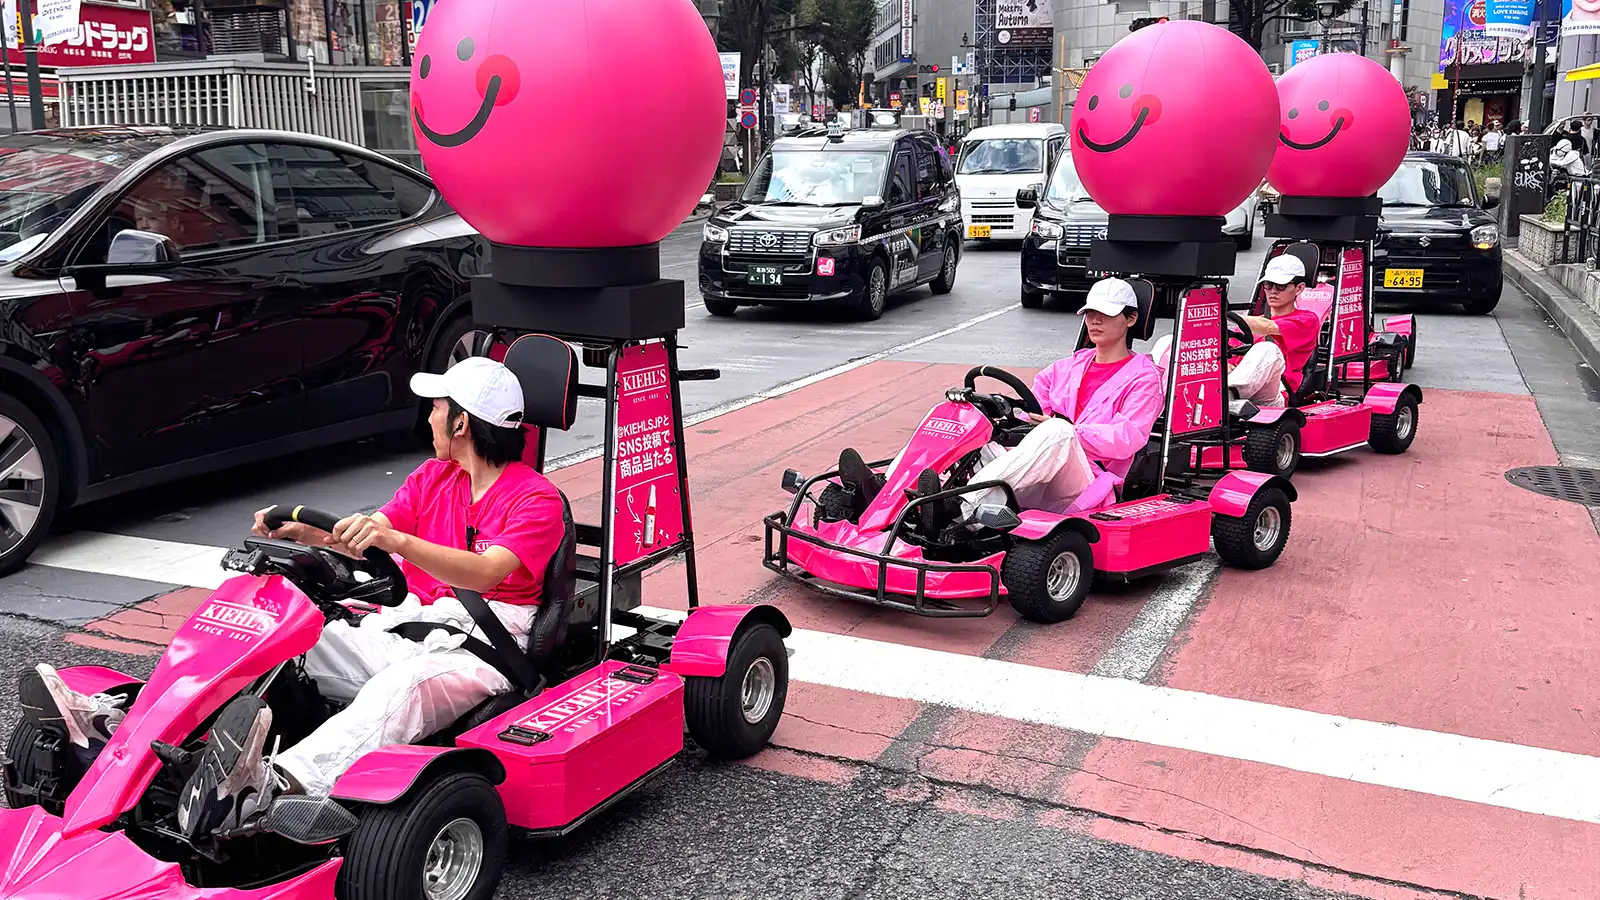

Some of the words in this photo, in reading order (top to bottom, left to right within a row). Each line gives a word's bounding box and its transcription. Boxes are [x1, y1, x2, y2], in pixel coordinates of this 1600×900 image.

[998, 13, 1028, 26] Autumn
[1392, 276, 1421, 287] 64-95
[1187, 305, 1219, 319] KIEHL'S
[1180, 347, 1219, 363] SNS投稿で
[1180, 360, 1219, 377] 商品当たる
[622, 368, 667, 391] KIEHL'S
[632, 396, 646, 404] SINCE
[617, 414, 670, 439] @KIEHLSJPと
[925, 420, 968, 434] KIEHL'S
[618, 429, 671, 457] SNS投稿で
[619, 448, 673, 478] 商品当たる
[200, 603, 275, 632] KIEHL'S
[192, 623, 223, 636] SINCE
[522, 678, 627, 731] KIEHL'S
[564, 709, 607, 733] SINCE
